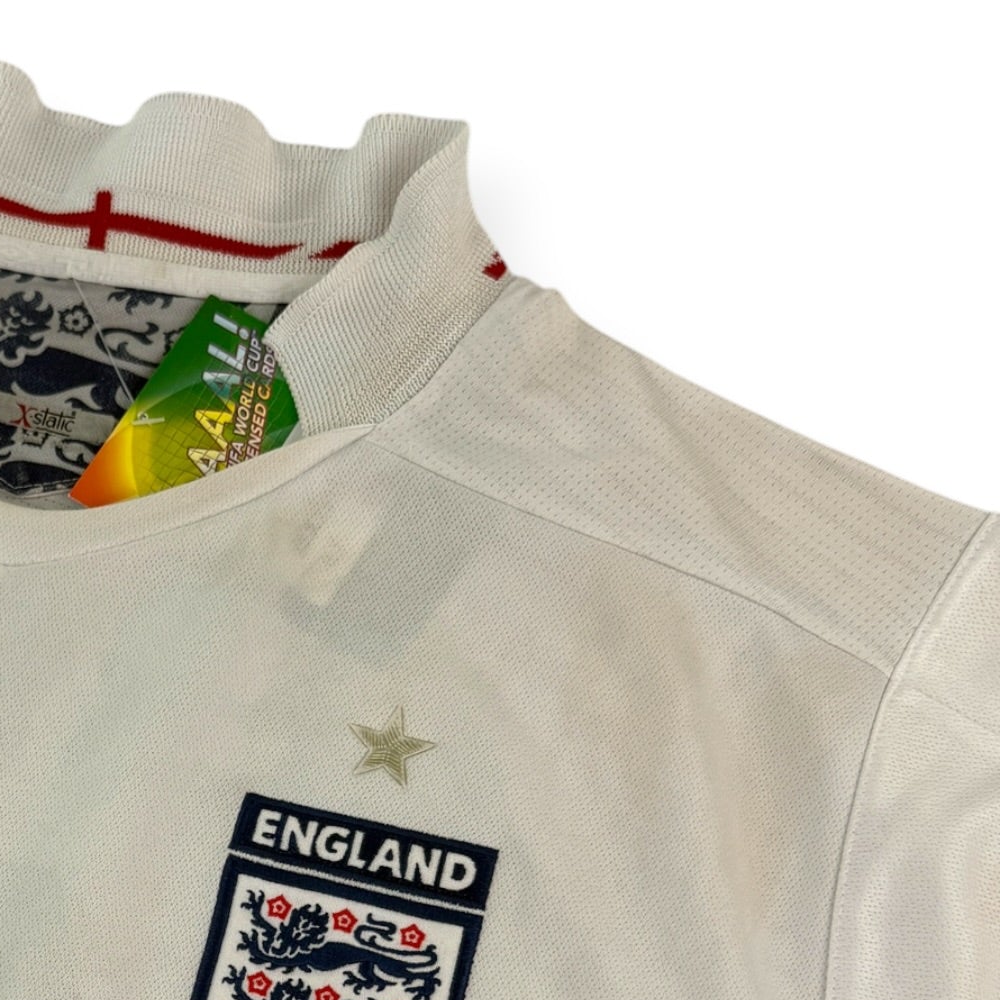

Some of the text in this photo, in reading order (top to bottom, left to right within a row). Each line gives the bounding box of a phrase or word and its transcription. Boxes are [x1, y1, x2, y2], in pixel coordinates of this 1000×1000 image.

[234, 377, 255, 436] WORLD
[246, 402, 267, 460] ENSED
[252, 809, 477, 891] ENGLAND
